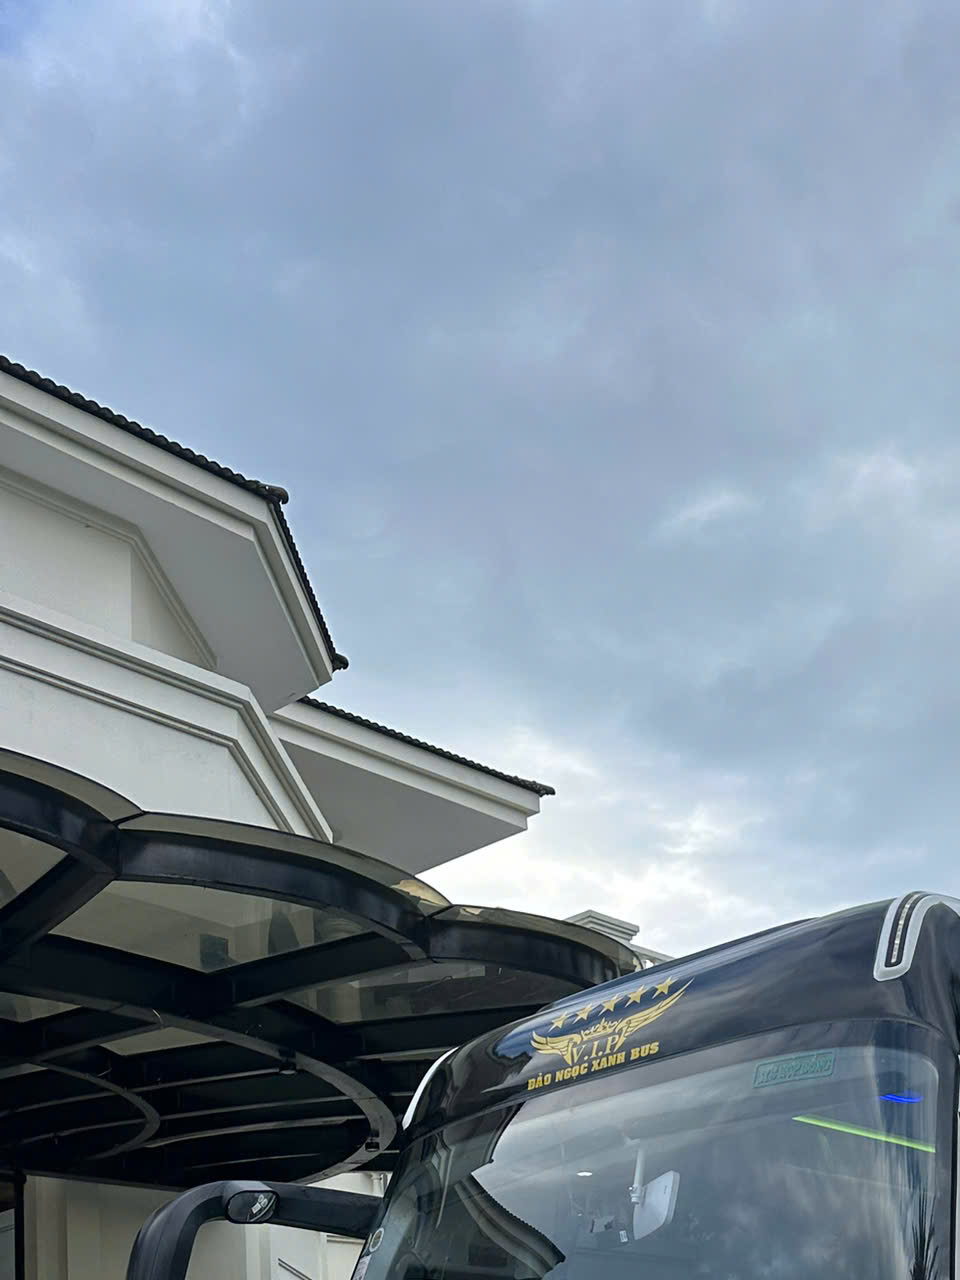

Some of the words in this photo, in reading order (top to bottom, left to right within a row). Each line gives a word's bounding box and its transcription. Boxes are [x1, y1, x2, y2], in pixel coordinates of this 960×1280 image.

[527, 1072, 552, 1090] BẢO
[555, 1063, 588, 1082] NGỌC
[591, 1051, 626, 1072] XANH
[630, 1041, 660, 1060] BUS
